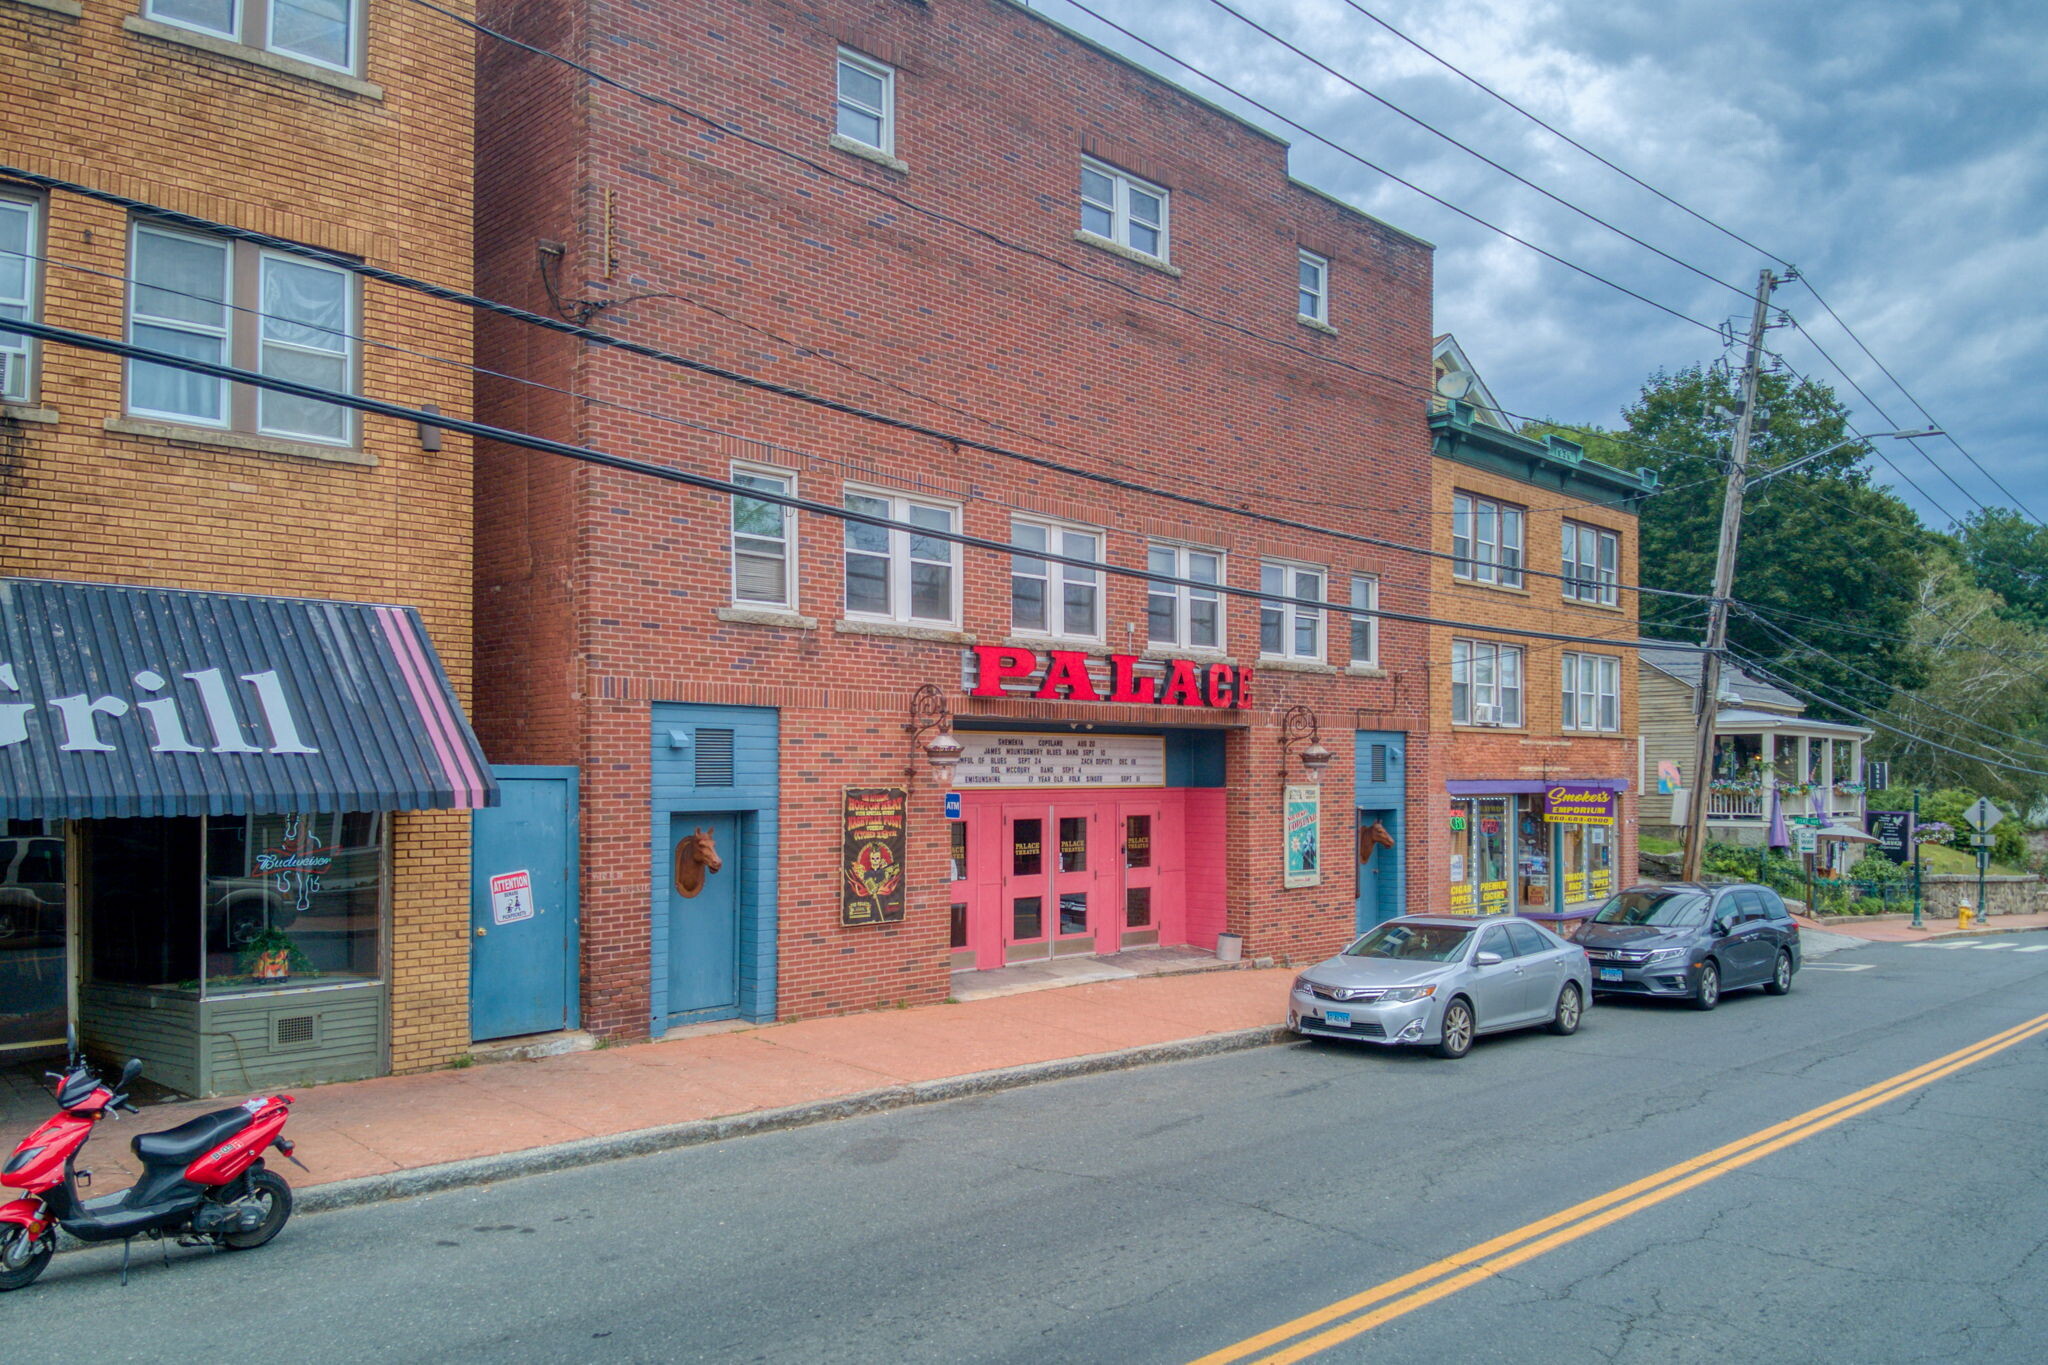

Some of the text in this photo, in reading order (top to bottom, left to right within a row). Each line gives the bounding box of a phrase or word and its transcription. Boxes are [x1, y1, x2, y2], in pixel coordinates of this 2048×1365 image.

[970, 645, 1253, 709] PALACE
[998, 738, 1024, 746] SHEMEKIA
[983, 747, 1002, 755] JAMES
[1046, 748, 1062, 756] BLUES
[990, 757, 1007, 765] BLUES
[1018, 757, 1031, 765] SEPT
[1040, 766, 1054, 774] BAND
[1547, 786, 1612, 806] Smoker's
[946, 801, 960, 811] ATM
[1551, 805, 1607, 815] EMPORIUM
[1015, 842, 1040, 850] PALACE
[256, 854, 332, 870] Budweiser
[493, 875, 529, 892] ATTENTION
[1480, 881, 1508, 892] PREMIUM
[1451, 894, 1473, 905] PIPES
[1487, 904, 1502, 914] VAPE
